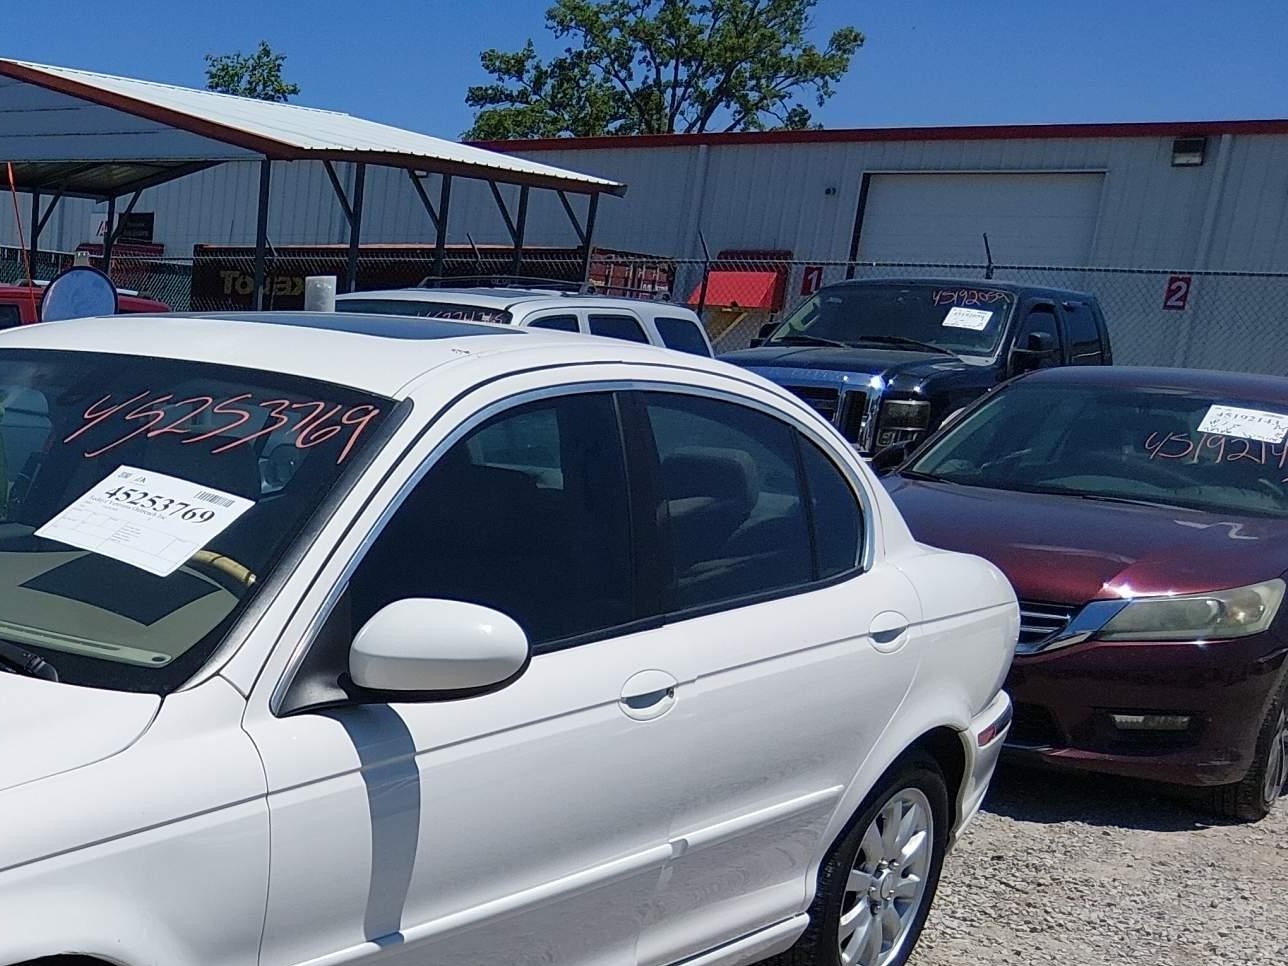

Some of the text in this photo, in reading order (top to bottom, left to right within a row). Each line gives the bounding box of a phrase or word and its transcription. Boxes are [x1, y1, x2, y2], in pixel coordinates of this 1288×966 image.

[807, 270, 818, 292] 1
[1166, 281, 1188, 306] 2
[64, 390, 380, 465] 45253769
[105, 486, 216, 523] 45253769
